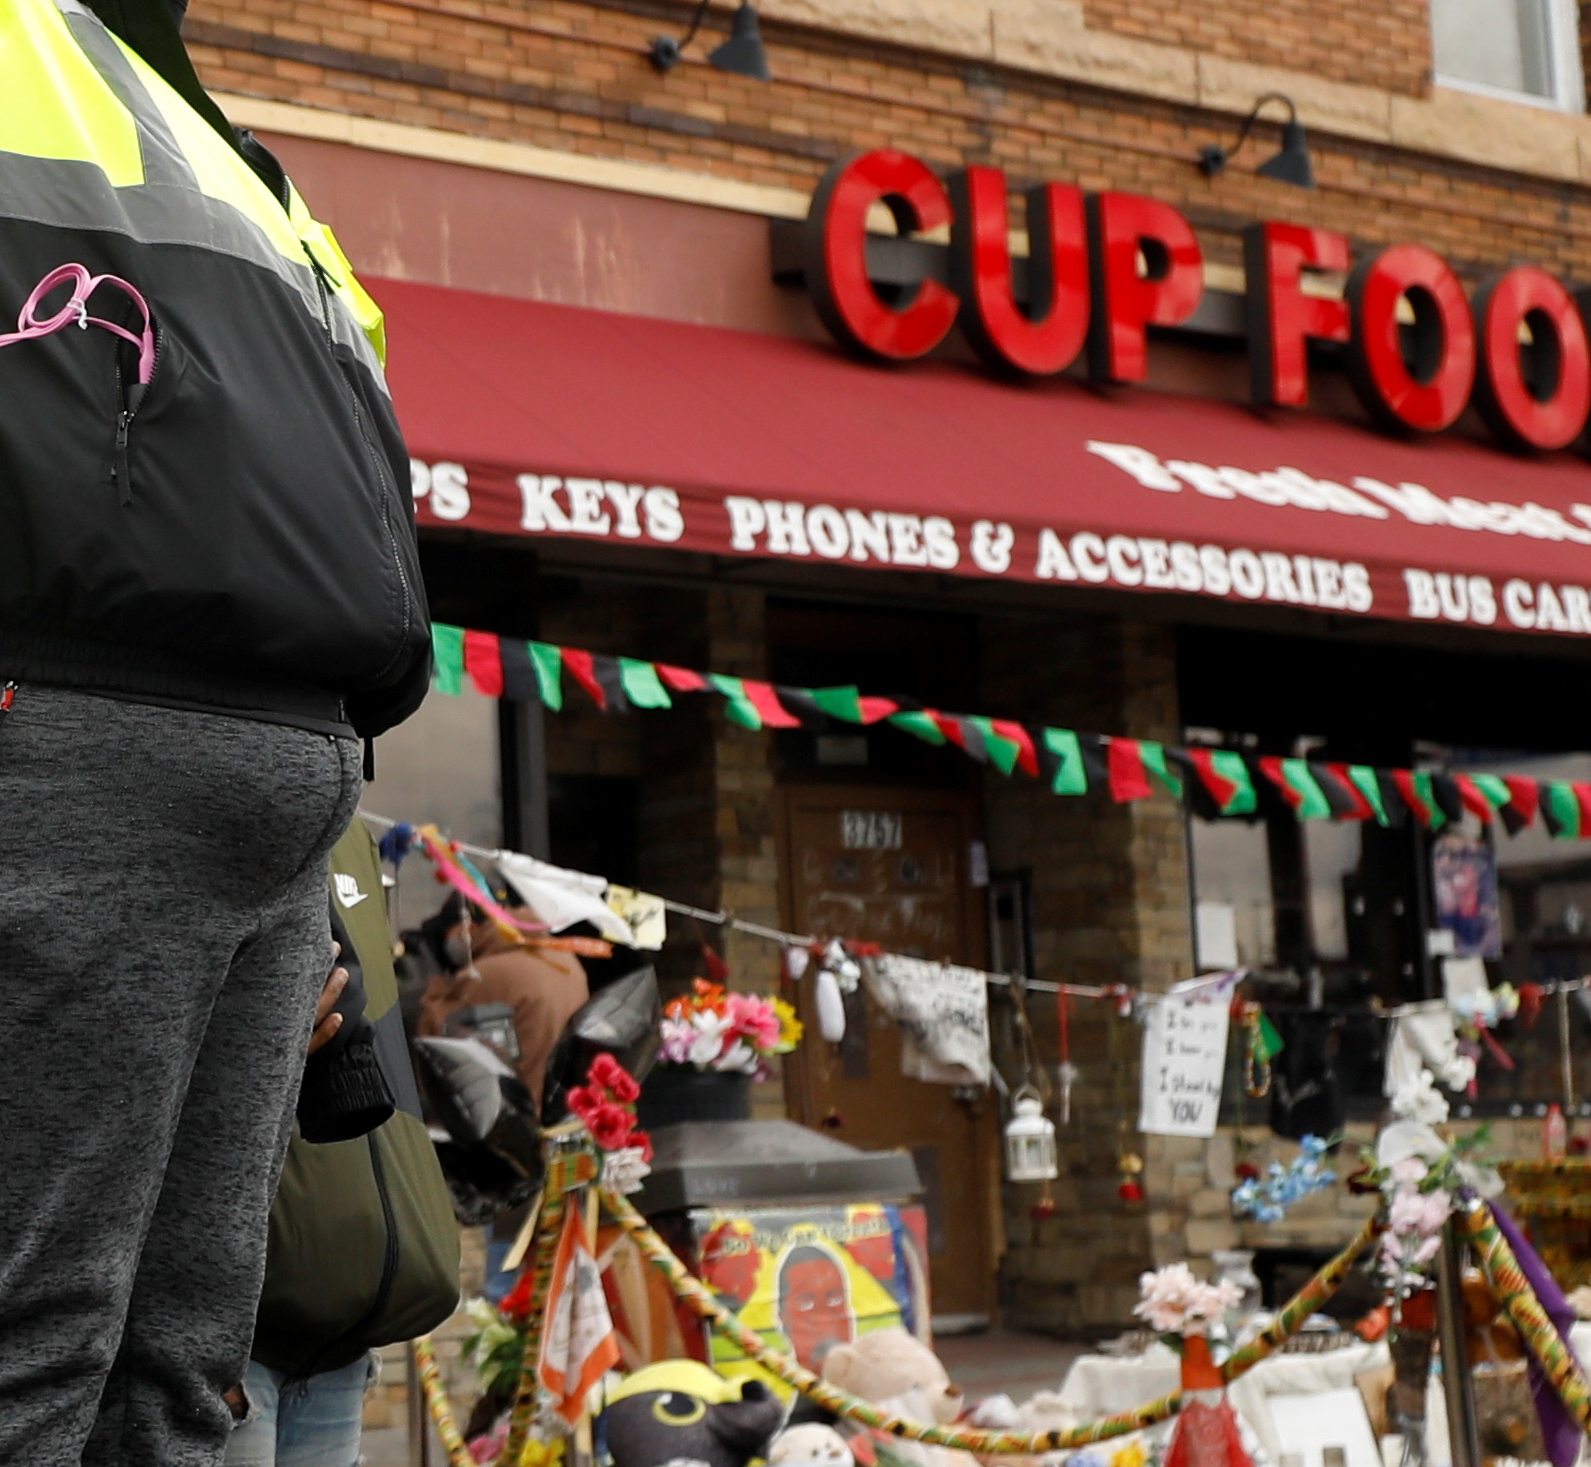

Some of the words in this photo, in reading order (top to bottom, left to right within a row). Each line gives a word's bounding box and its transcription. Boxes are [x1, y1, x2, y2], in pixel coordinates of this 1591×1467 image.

[815, 147, 1204, 384] CUP
[517, 472, 685, 543] KEYS
[723, 494, 960, 570] PHONES
[970, 519, 1015, 574] &
[1035, 527, 1373, 613] ACCESSORIES
[1404, 567, 1496, 625] BUS
[1171, 1097, 1203, 1123] YOU
